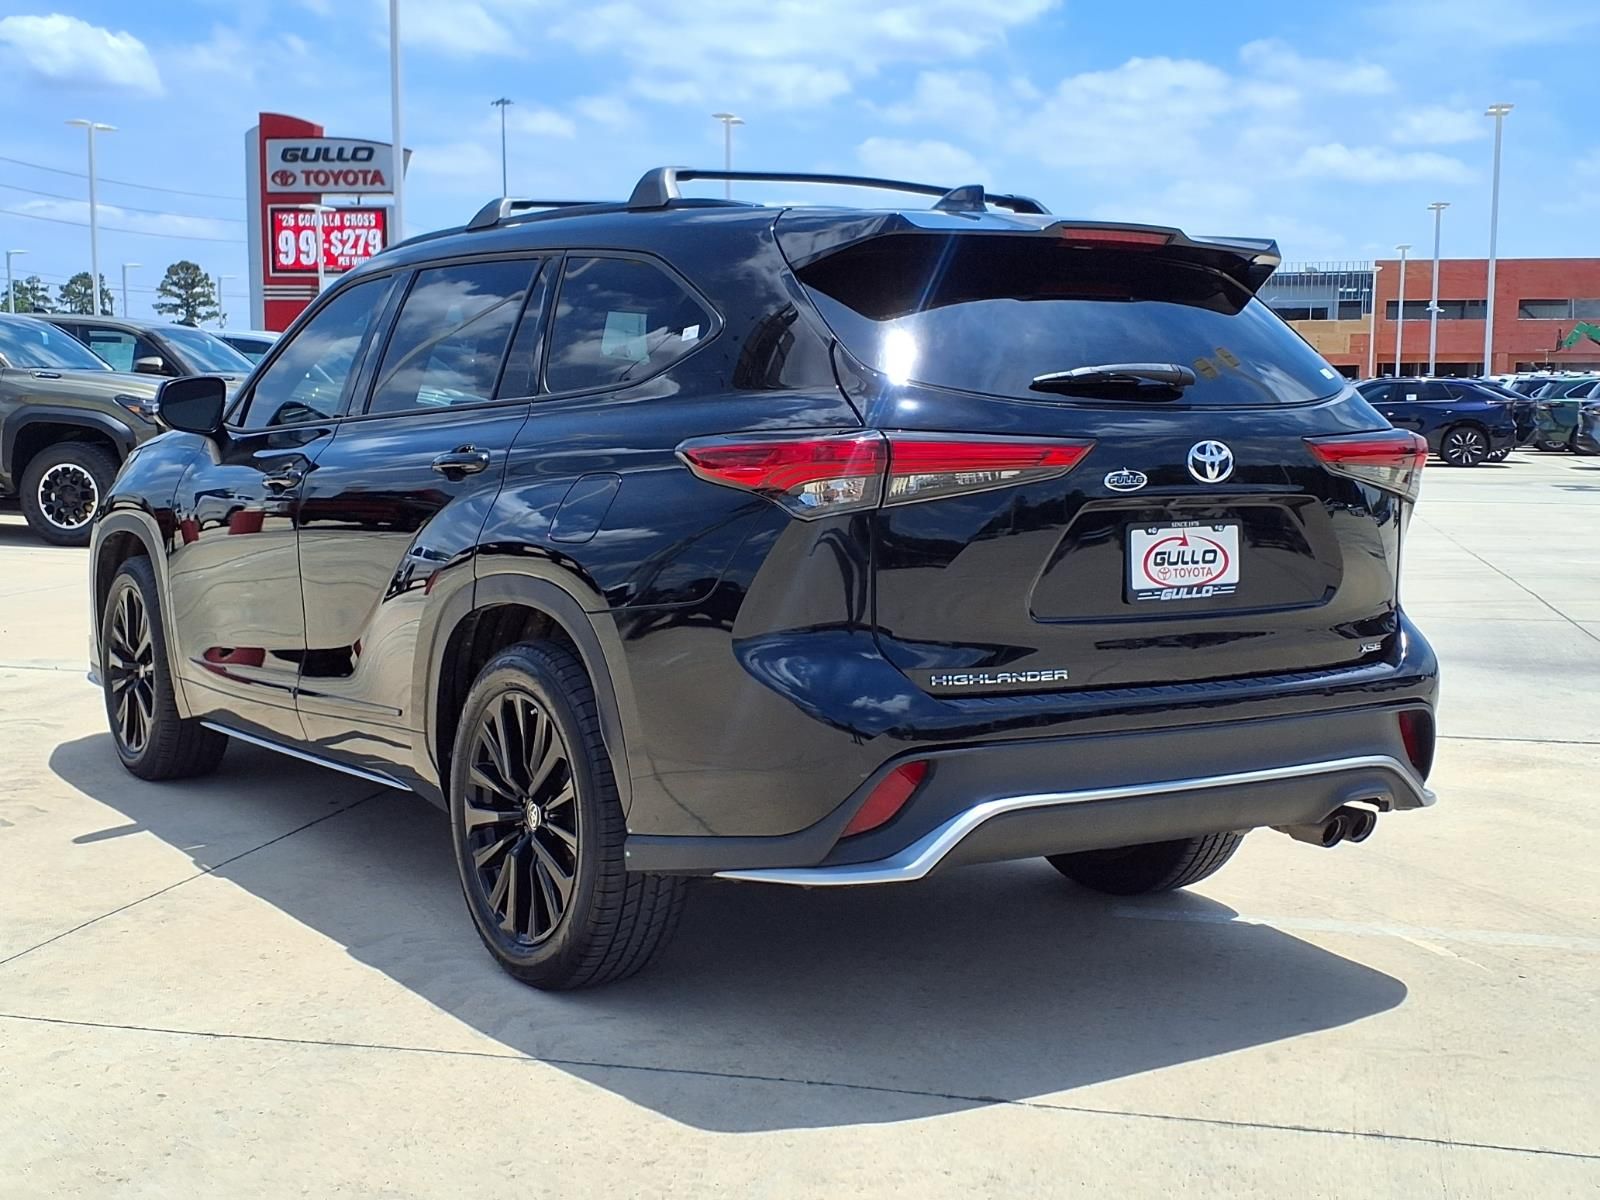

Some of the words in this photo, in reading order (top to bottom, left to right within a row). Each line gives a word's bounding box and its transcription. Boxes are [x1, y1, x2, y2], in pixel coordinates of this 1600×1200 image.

[281, 147, 375, 162] GULLO
[301, 169, 385, 186] TOYOTA
[343, 213, 376, 227] CROSS
[337, 256, 351, 266] PER
[1109, 474, 1145, 485] GULLO
[1153, 549, 1218, 567] GULLO
[1173, 567, 1213, 579] TOYOTA
[1160, 586, 1214, 600] GULLO
[1361, 642, 1382, 653] XSE
[931, 670, 1069, 686] HIGHLANDER
